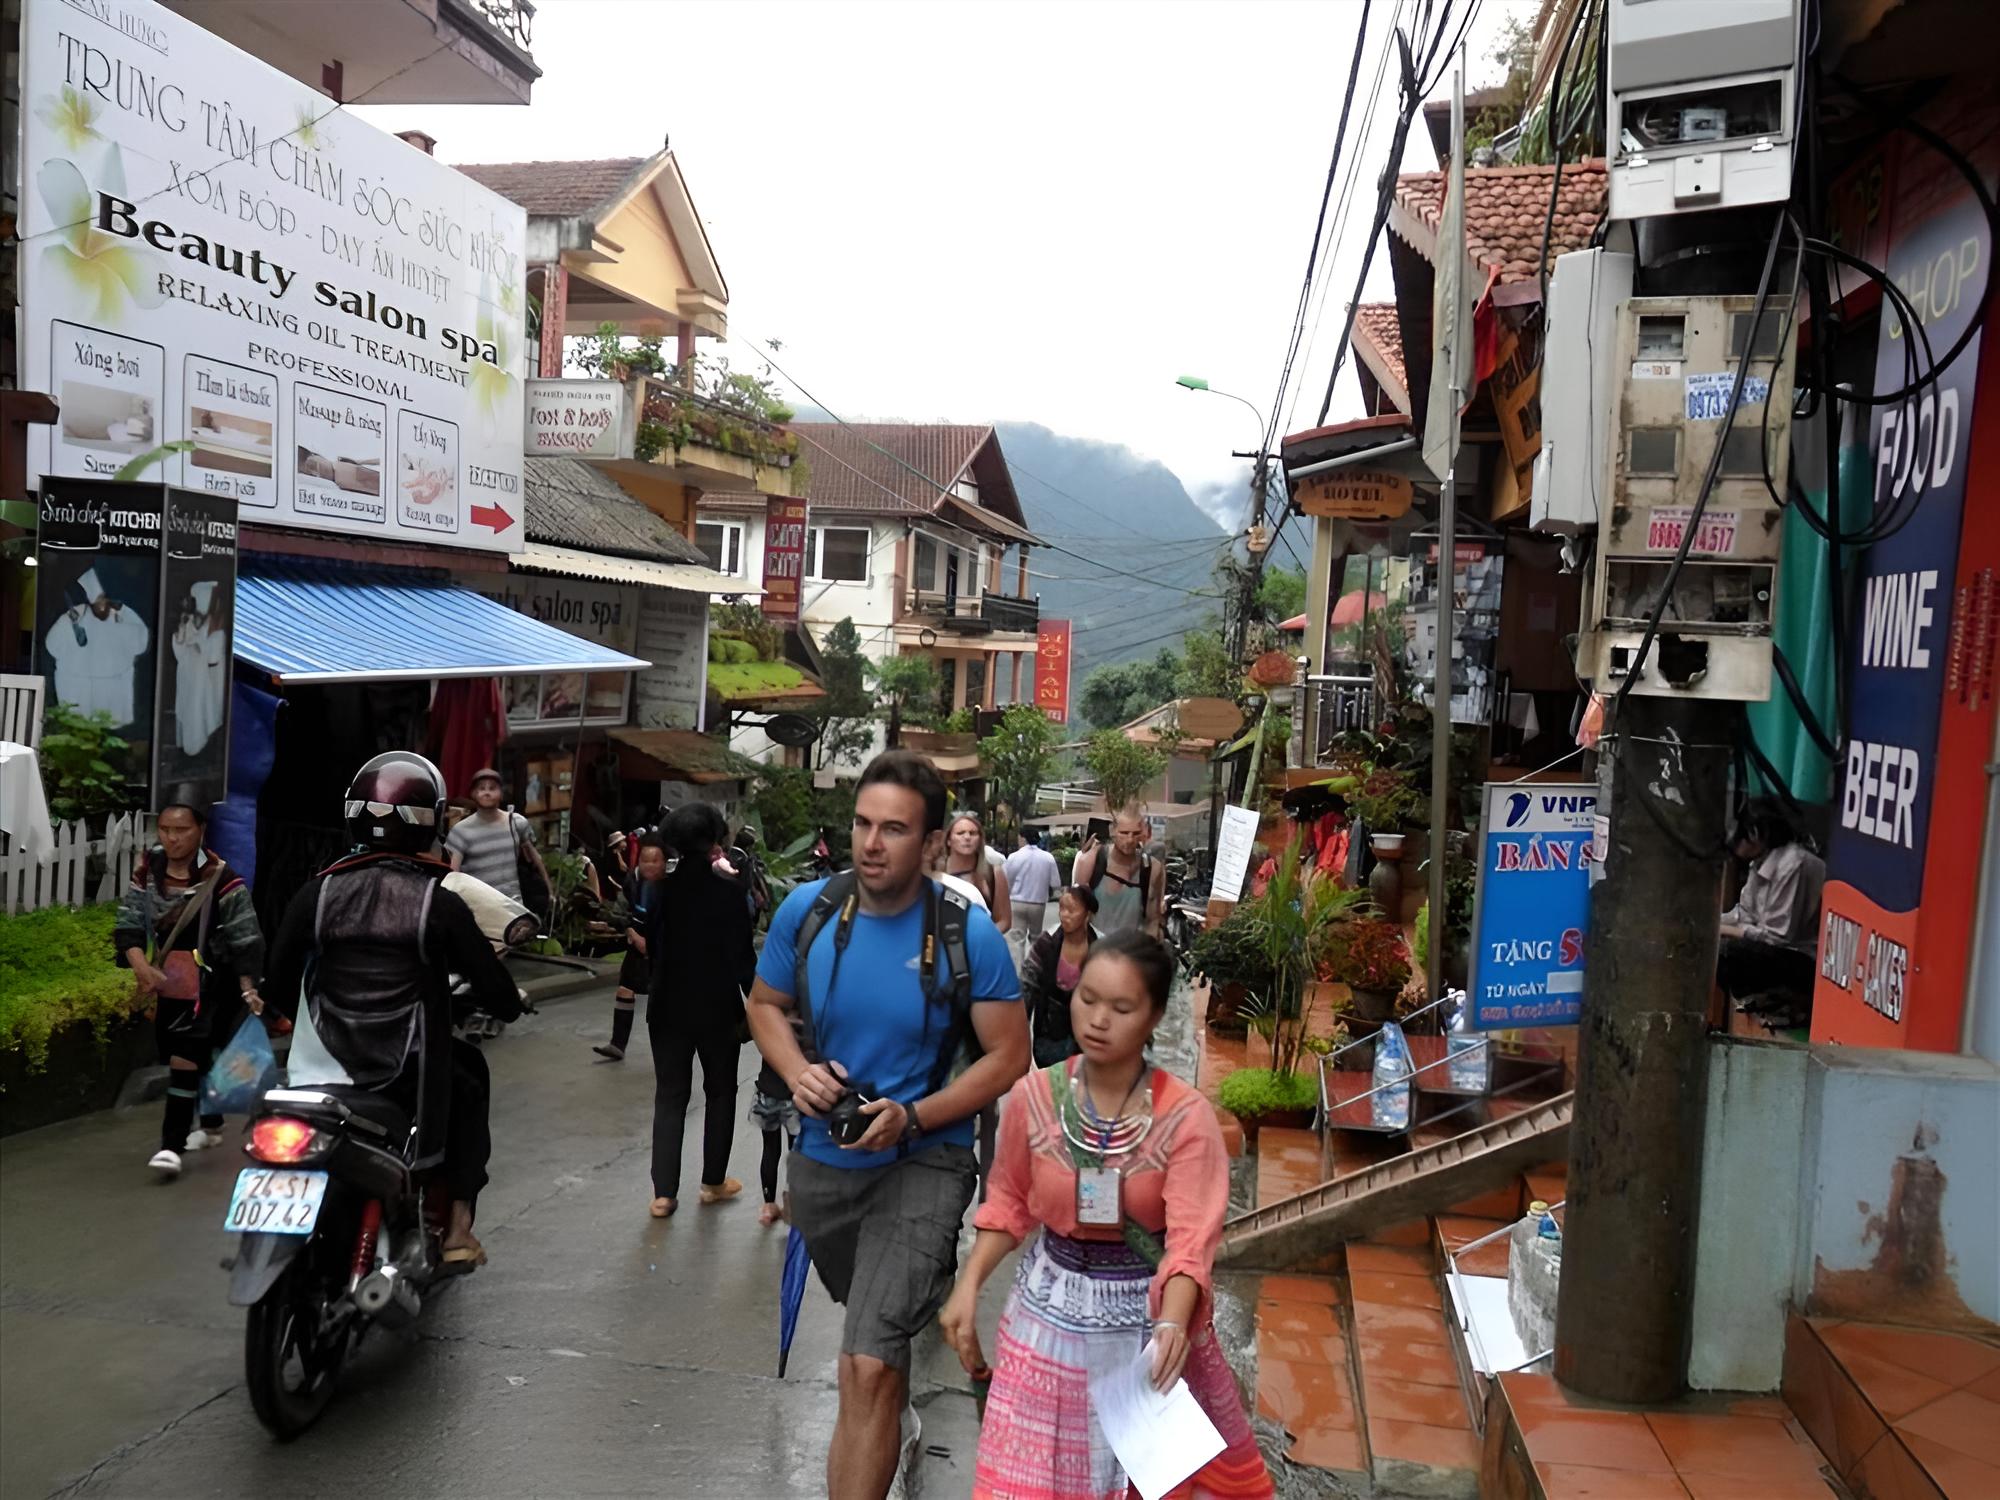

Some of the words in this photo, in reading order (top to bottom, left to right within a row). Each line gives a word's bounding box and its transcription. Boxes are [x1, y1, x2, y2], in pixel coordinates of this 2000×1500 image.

[58, 31, 187, 133] TRUNG
[96, 190, 297, 299] Beauty
[313, 281, 427, 340] salon
[440, 326, 499, 366] spa
[158, 272, 300, 336] RELAXING
[308, 321, 346, 349] OIL
[351, 334, 470, 388] TREATMENT
[248, 341, 414, 402] PROFESSIONAL
[1874, 386, 1960, 503] FOOD
[1862, 570, 1939, 669] WINE
[1841, 739, 1920, 850] BEER
[1495, 832, 1575, 872] BÁN
[232, 1201, 312, 1229] 007.42
